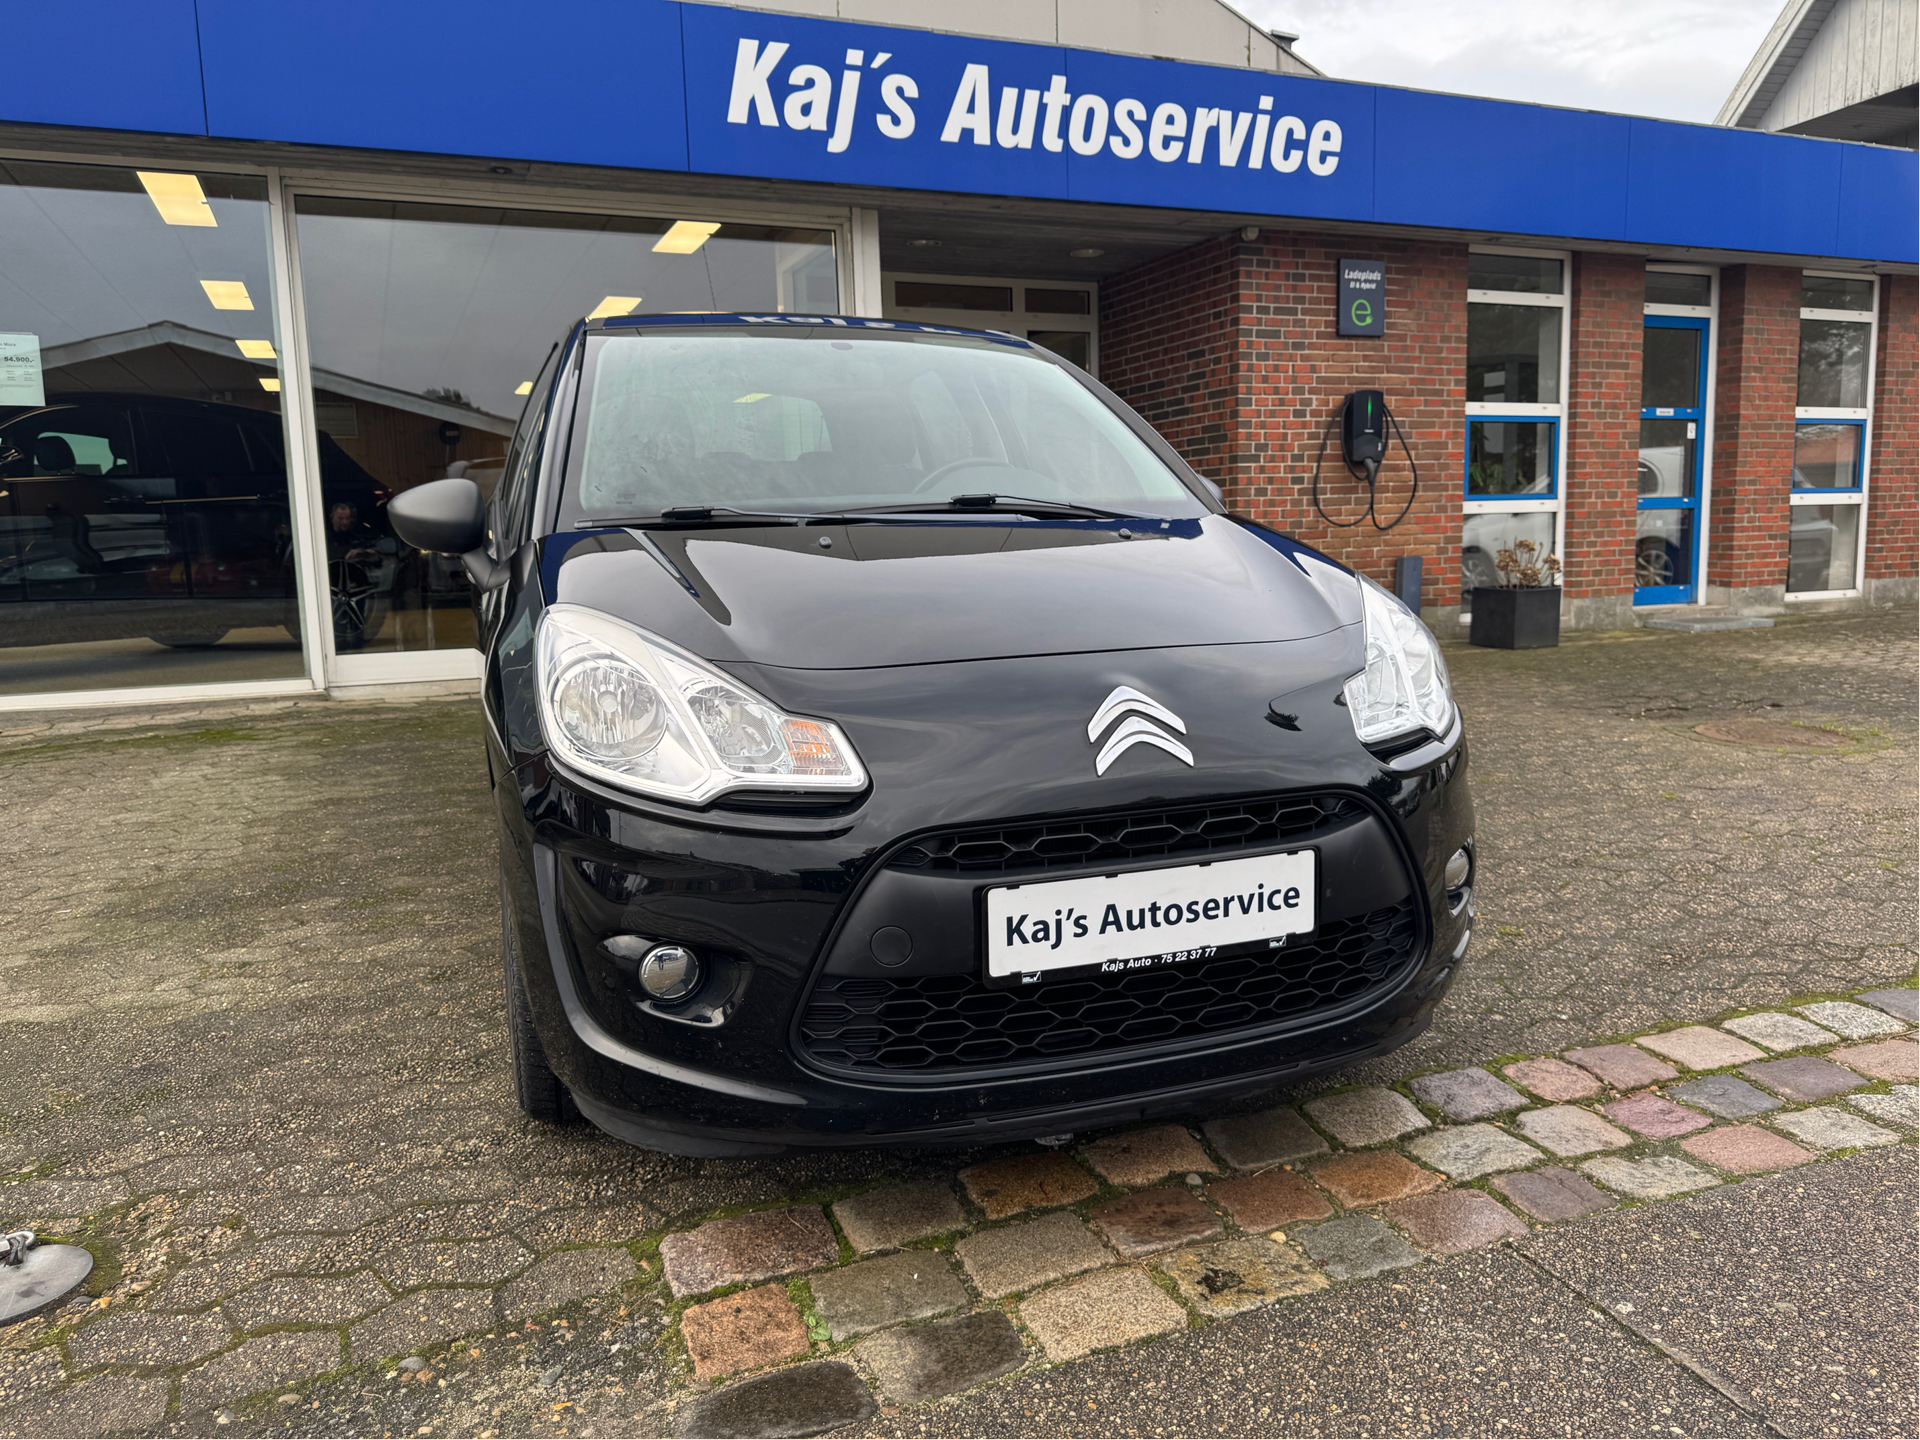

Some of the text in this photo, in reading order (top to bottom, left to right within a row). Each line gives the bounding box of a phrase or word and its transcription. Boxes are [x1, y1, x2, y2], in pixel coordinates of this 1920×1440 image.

[940, 63, 1343, 177] Autoservice
[1344, 268, 1381, 281] Ladeplads
[1006, 882, 1300, 950] Kaj's Autoservice
[1101, 961, 1125, 973] Kajs
[1127, 957, 1152, 969] Auto
[1161, 953, 1173, 964] 75
[1175, 951, 1188, 962] 22
[1190, 949, 1203, 960] 37
[1205, 946, 1217, 958] 77
